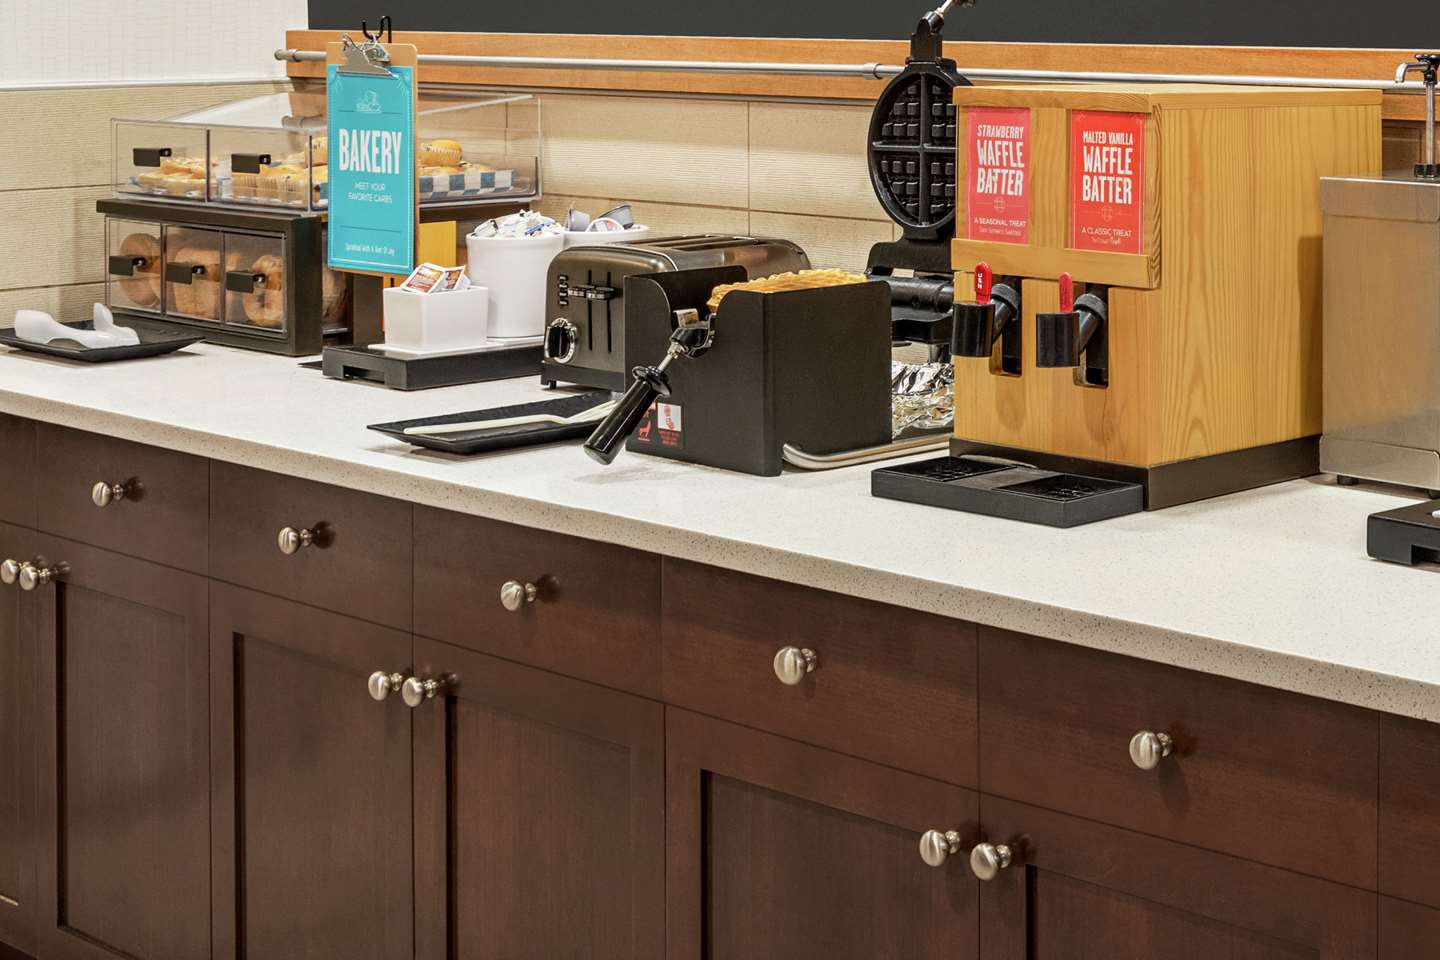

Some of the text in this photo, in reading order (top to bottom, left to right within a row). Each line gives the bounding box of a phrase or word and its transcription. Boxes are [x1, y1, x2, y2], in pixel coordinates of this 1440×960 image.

[977, 124, 1024, 139] STRAWBERRY
[1083, 131, 1133, 145] MALTED VANILLA
[339, 128, 402, 175] BAKERY
[977, 140, 1024, 168] WAFFLE
[1083, 146, 1133, 175] WAFFLE
[976, 168, 1024, 196] BATTER
[1082, 175, 1132, 204] BATTER
[980, 217, 1008, 227] SEASONAL
[1009, 220, 1026, 228] TREAT
[1087, 227, 1111, 237] CLASSIC
[1112, 229, 1132, 237] TREAT
